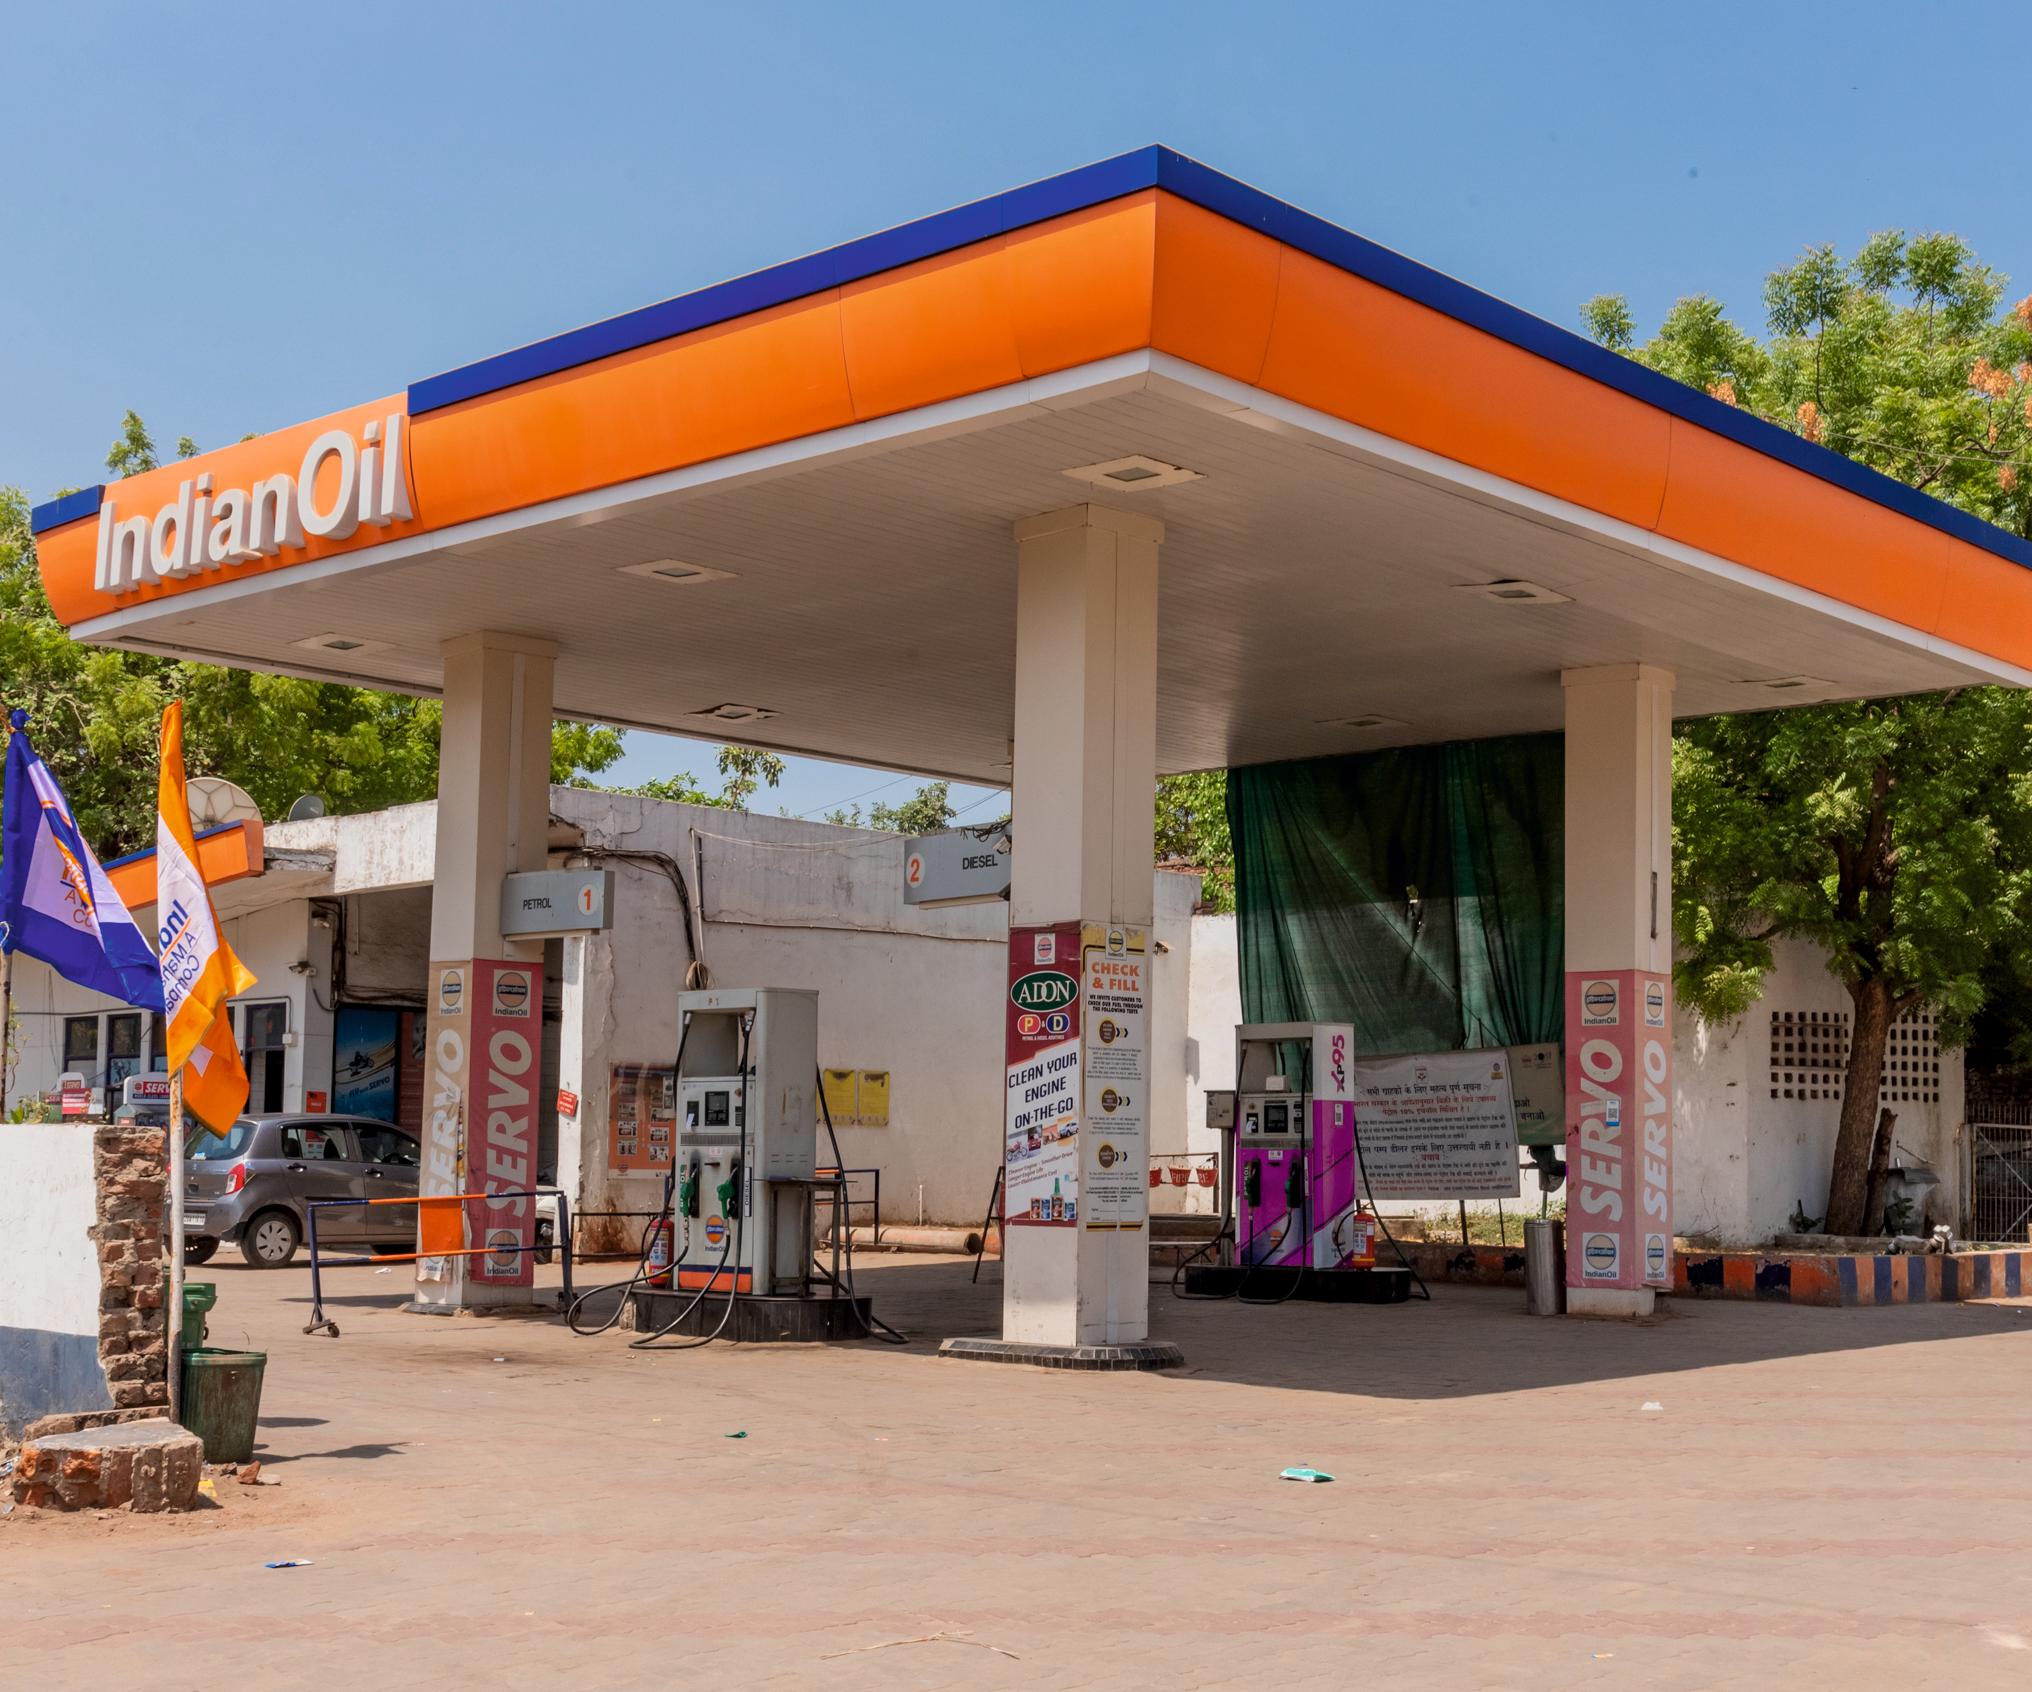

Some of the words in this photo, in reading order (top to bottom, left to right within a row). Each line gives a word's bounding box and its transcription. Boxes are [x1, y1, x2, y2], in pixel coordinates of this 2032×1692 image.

[94, 413, 413, 595] IndianOil
[910, 858, 920, 883] 2
[962, 854, 998, 870] DIESEL
[522, 897, 552, 911] PETROL
[583, 888, 592, 912] 1
[1091, 961, 1140, 977] CHECK
[1018, 980, 1072, 1003] ADON
[1092, 977, 1104, 990] &
[1109, 978, 1139, 992] FILL
[495, 1007, 528, 1016] IndianOil
[1584, 1017, 1617, 1025] IndianOil
[1025, 1017, 1034, 1032] P
[1053, 1016, 1063, 1031] D
[1008, 1064, 1043, 1088] CLEAN
[1047, 1052, 1077, 1074] YOUR
[145, 1082, 170, 1093] SERV
[1025, 1076, 1067, 1103] ENGINE
[484, 1030, 532, 1218] SERVO
[1015, 1097, 1073, 1129] ON-THE-GO
[1579, 1039, 1623, 1222] SERVO
[1643, 1040, 1668, 1223] SERVO
[486, 1266, 519, 1275] IndianOil
[1585, 1270, 1617, 1278] IndianOil
